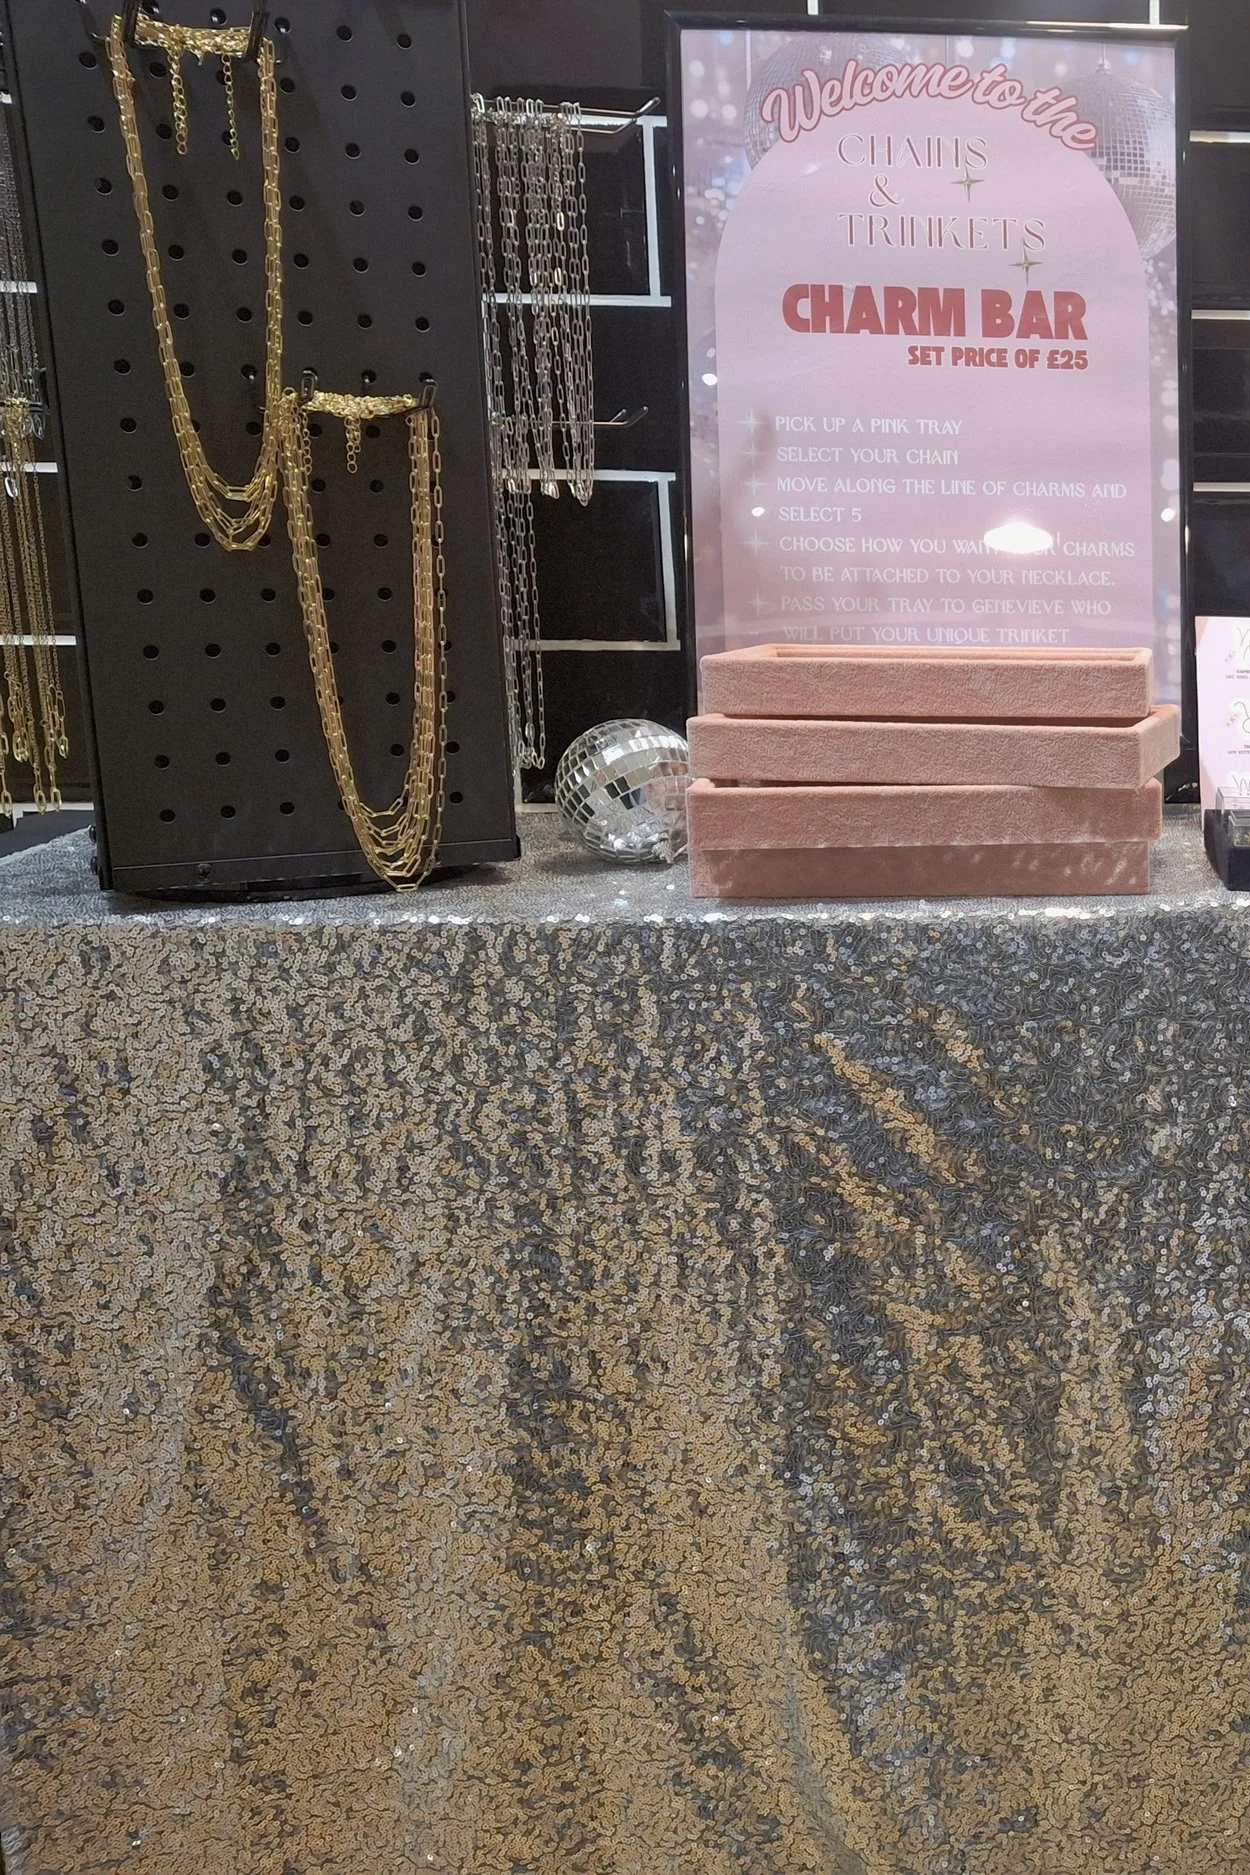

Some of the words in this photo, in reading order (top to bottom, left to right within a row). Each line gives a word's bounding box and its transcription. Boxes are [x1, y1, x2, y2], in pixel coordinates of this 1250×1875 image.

[761, 59, 974, 143] Welcome
[971, 63, 1026, 108] to
[1023, 87, 1097, 150] the
[836, 133, 988, 170] CHAINS
[868, 174, 905, 207] &
[837, 212, 1047, 251] TRINKETS
[782, 283, 966, 337] CHARM
[981, 289, 1088, 341] BAR
[907, 345, 946, 366] SET
[951, 346, 1008, 368] PRICE
[1014, 348, 1042, 369] OF
[1046, 348, 1089, 371] £25
[774, 416, 817, 433] PICK
[823, 417, 847, 433] UP
[852, 417, 865, 434] A
[870, 418, 910, 435] PINK
[915, 419, 962, 435] TRAY
[776, 447, 844, 464] SELECT
[849, 448, 900, 464] YOUR
[906, 449, 959, 465] CHAIN
[776, 477, 828, 493] MOVE
[833, 478, 896, 494] ALONG
[902, 479, 934, 495] THE
[940, 480, 975, 496] LINE
[982, 480, 1007, 496] OF
[1013, 481, 1086, 498] CHARMS
[1091, 482, 1127, 498] AND
[778, 507, 845, 523] SELECT
[850, 507, 862, 523] 5
[779, 537, 855, 553] CHOOSE
[861, 538, 903, 554] HOW
[909, 538, 946, 554] YOU
[1063, 541, 1135, 558] CHARMS
[780, 566, 806, 582] TO
[812, 567, 834, 583] BE
[840, 567, 929, 584] ATTACHED
[935, 569, 961, 584] TO
[966, 569, 1014, 585] YOUR
[1022, 570, 1115, 587] NECKLACE.
[781, 597, 825, 612] PASS
[832, 597, 880, 612] YOUR
[888, 598, 933, 613] TRAY
[942, 599, 965, 613] TO
[972, 599, 1064, 615] GENEVIEVE
[1071, 600, 1112, 615] WHO
[783, 626, 823, 641] WILL
[830, 627, 864, 641] PUT
[872, 627, 920, 642] YOUR
[927, 627, 990, 644] UNIQUE
[996, 629, 1070, 644] TRINKET
